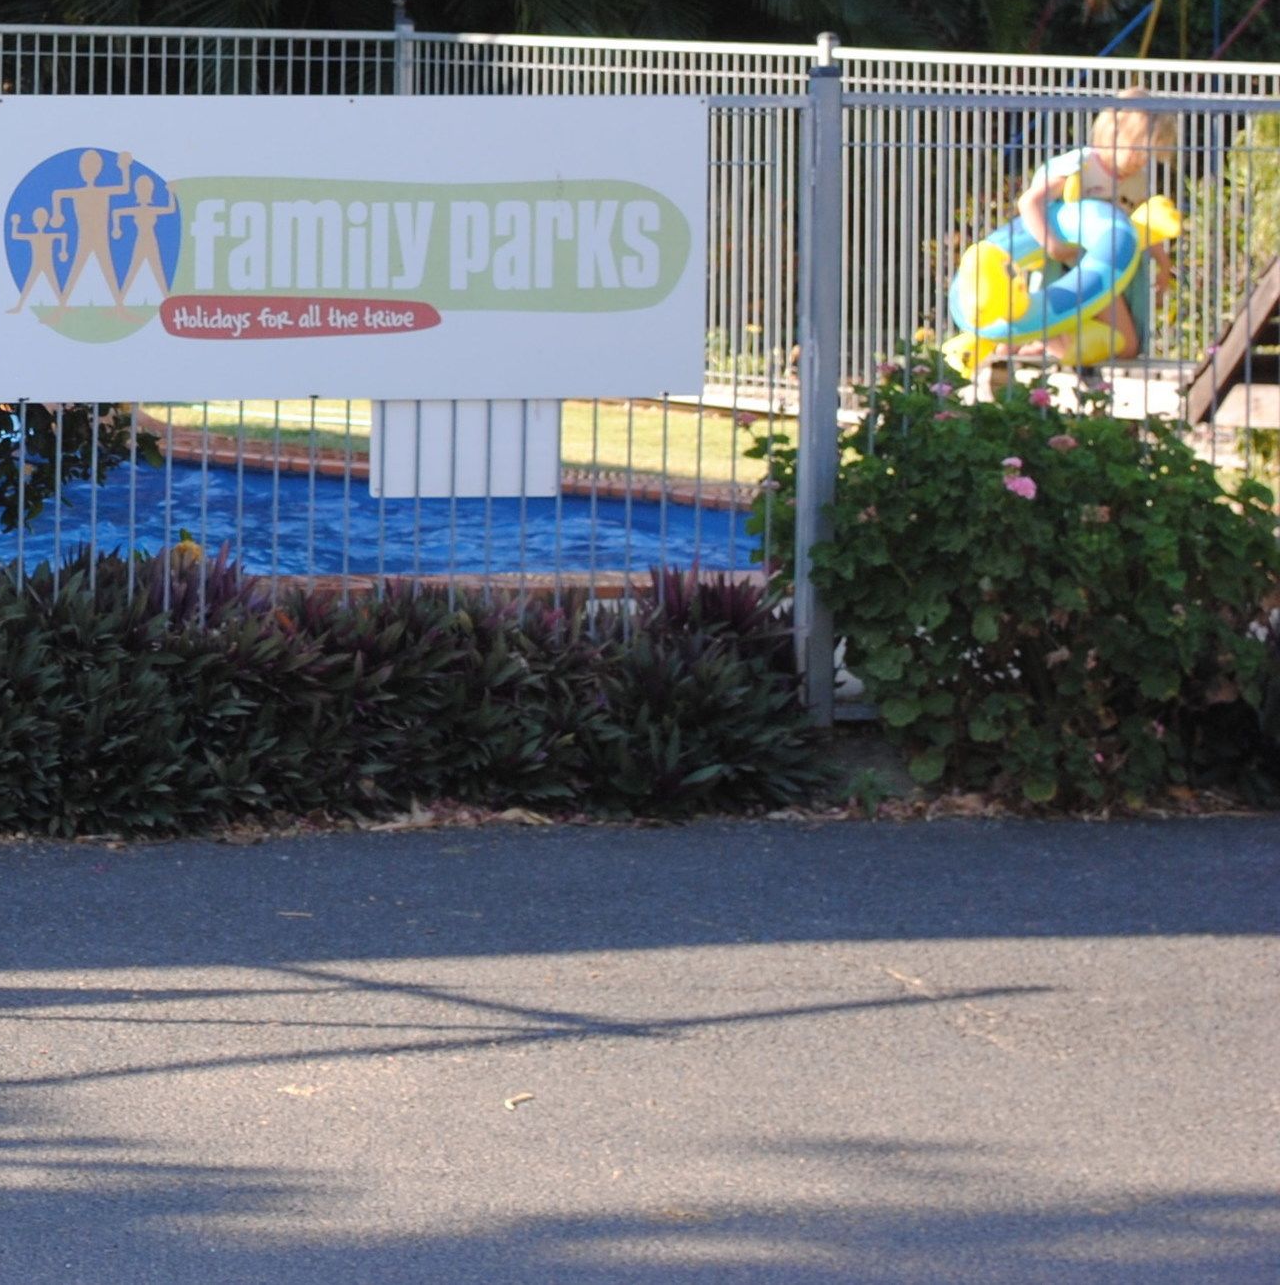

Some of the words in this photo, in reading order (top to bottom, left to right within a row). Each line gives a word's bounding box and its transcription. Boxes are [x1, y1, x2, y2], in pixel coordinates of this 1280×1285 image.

[190, 199, 435, 290] family
[173, 306, 251, 336] Holidays
[299, 305, 321, 328] all
[327, 307, 357, 328] the
